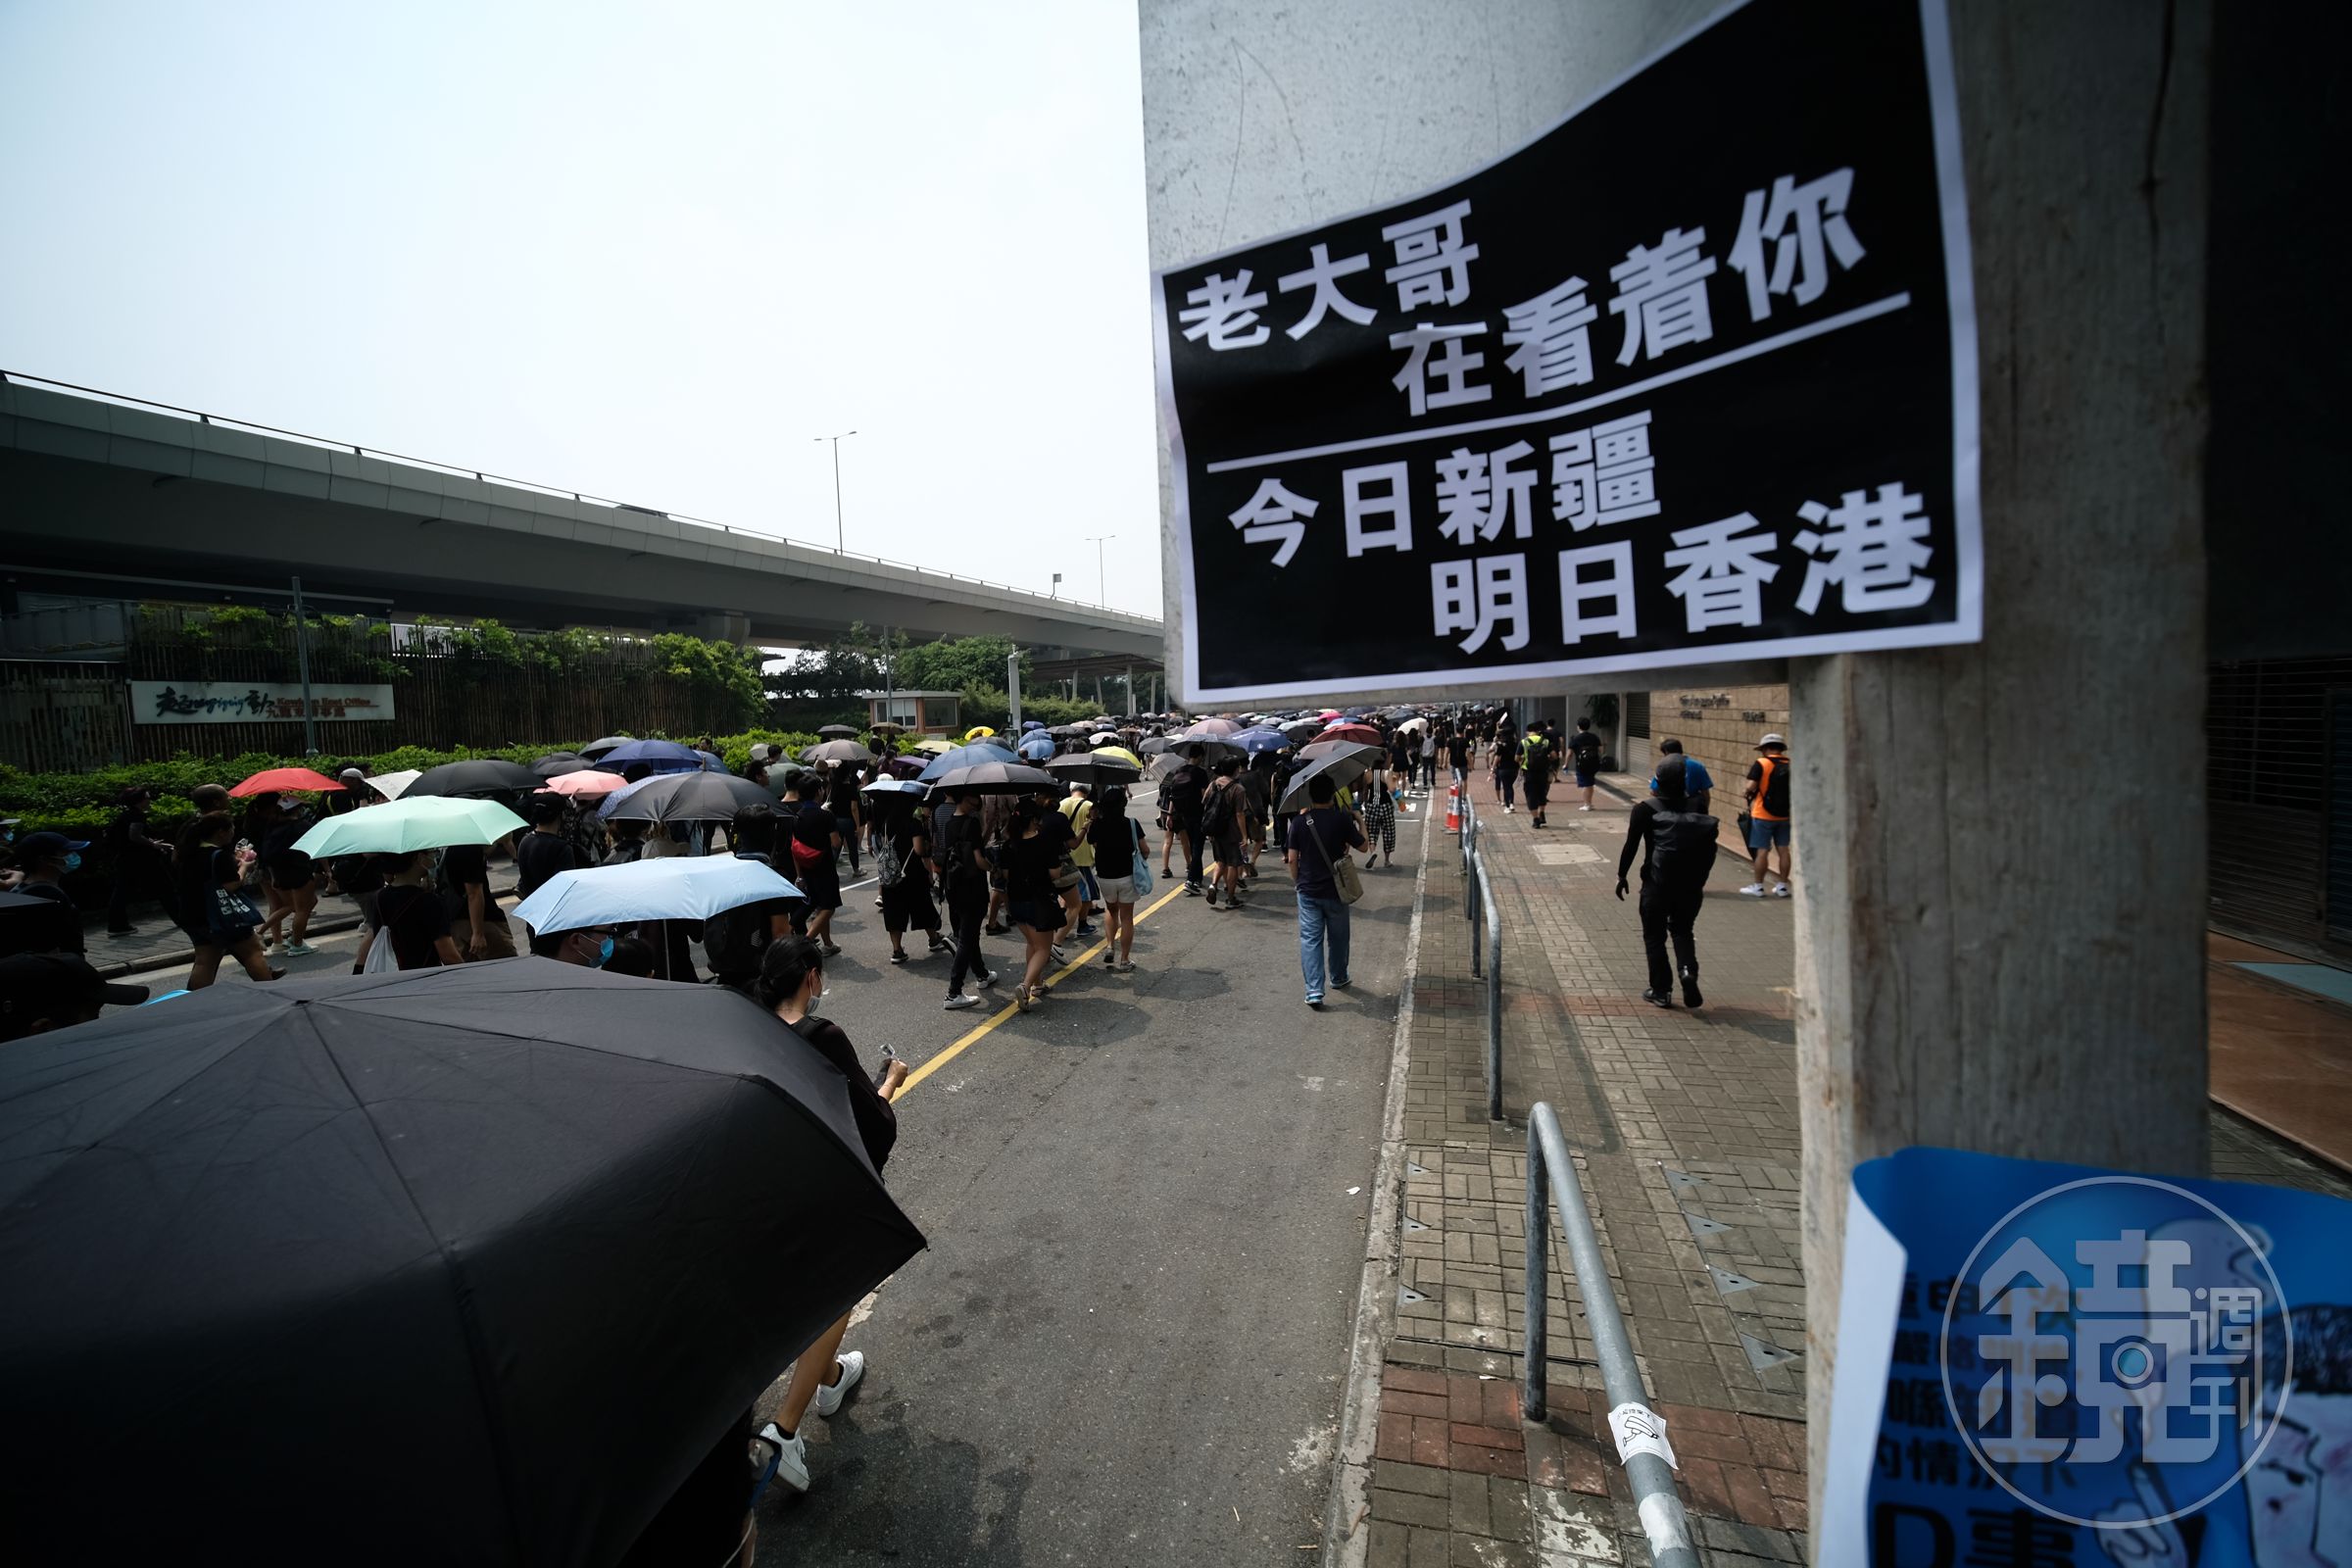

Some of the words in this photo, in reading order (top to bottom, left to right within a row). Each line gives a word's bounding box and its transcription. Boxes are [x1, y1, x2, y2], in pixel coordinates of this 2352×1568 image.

[1178, 199, 1480, 353] 老大哥
[1390, 167, 1867, 416] 在看着你
[1228, 410, 1662, 567] 今日新疆
[1431, 481, 1936, 655] 明日香港
